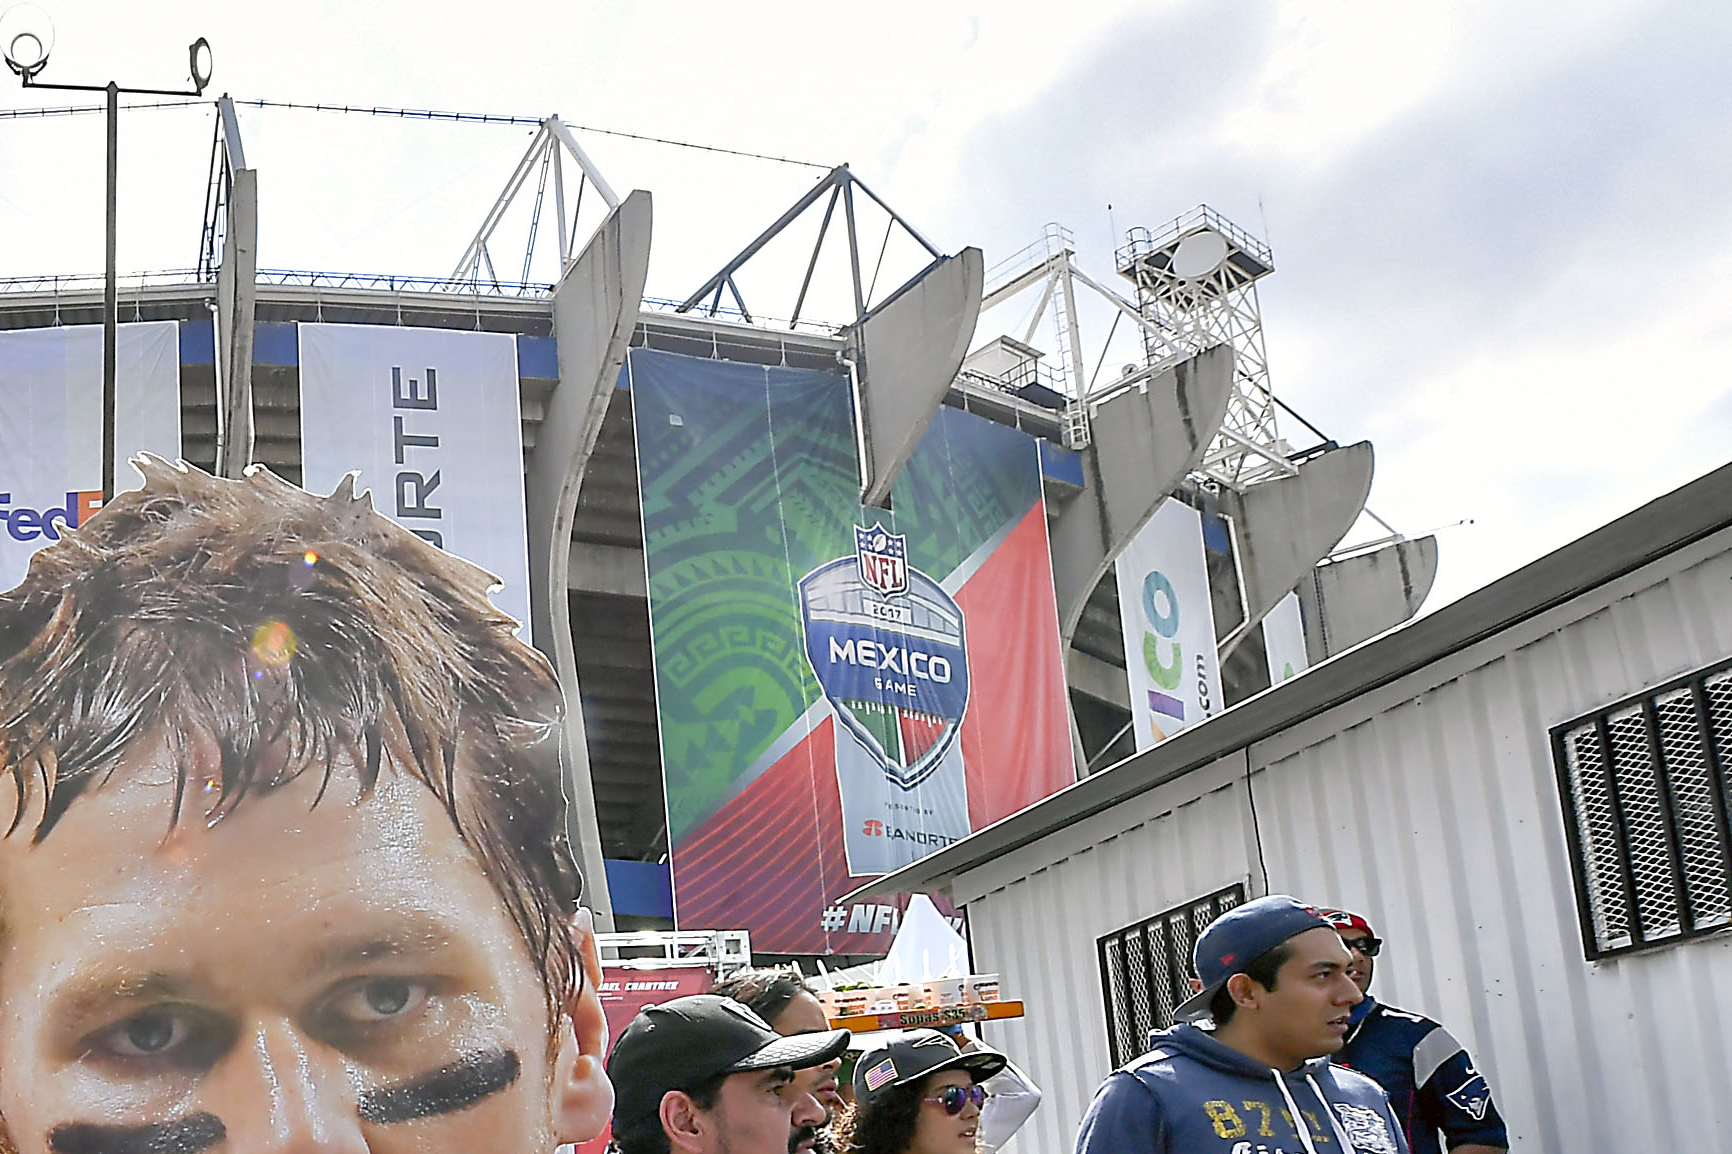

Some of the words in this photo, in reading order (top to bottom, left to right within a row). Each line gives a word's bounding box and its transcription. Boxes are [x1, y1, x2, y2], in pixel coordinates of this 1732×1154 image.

[391, 366, 443, 549] RTE
[863, 553, 903, 590] NFL
[873, 604, 901, 620] 2017
[829, 635, 951, 684] MEXICO
[874, 677, 917, 697] GAME
[1204, 1100, 1275, 1138] 87
